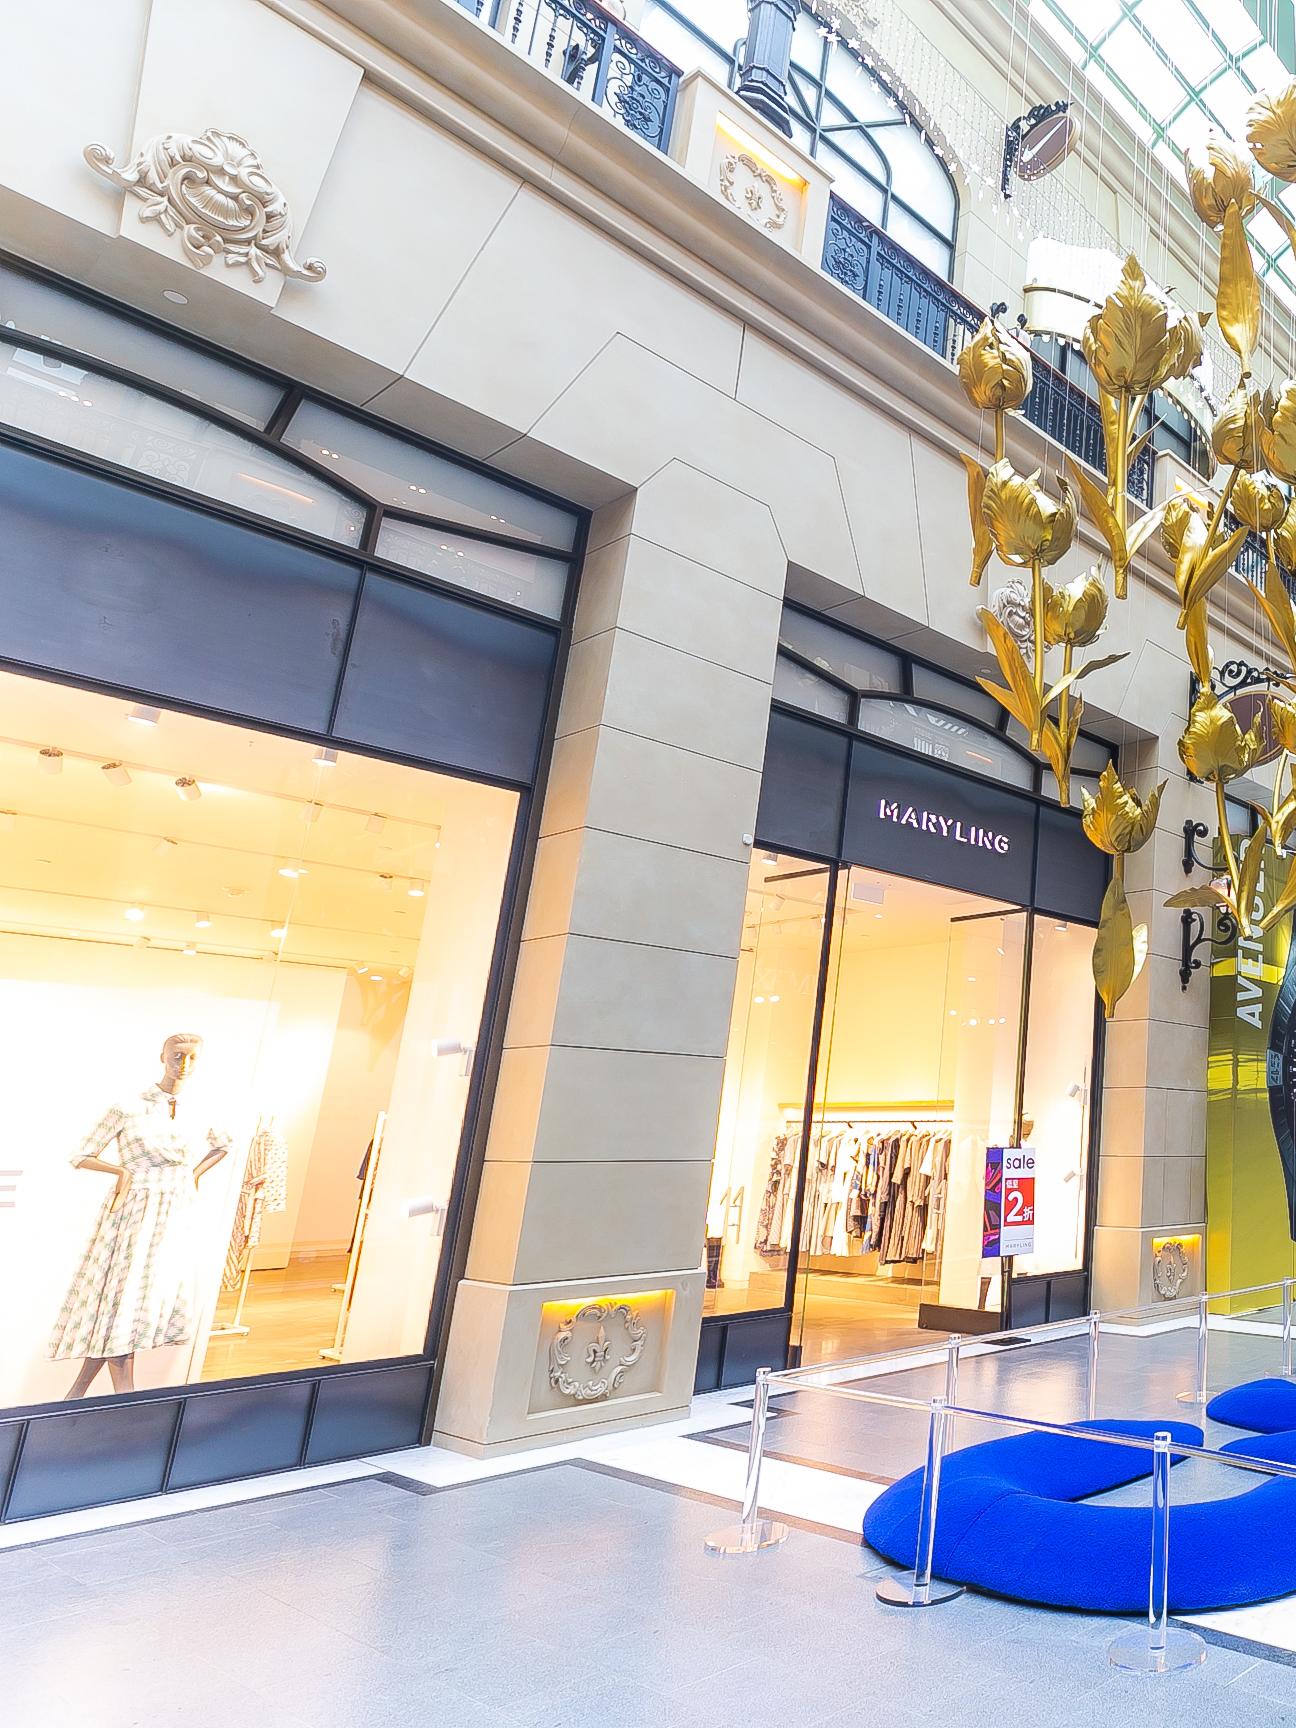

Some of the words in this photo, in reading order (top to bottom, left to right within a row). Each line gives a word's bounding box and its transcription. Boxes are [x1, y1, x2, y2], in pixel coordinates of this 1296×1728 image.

[879, 799, 1010, 854] MARYLING
[1236, 838, 1265, 1030] AVENG
[1006, 1155, 1035, 1170] sale
